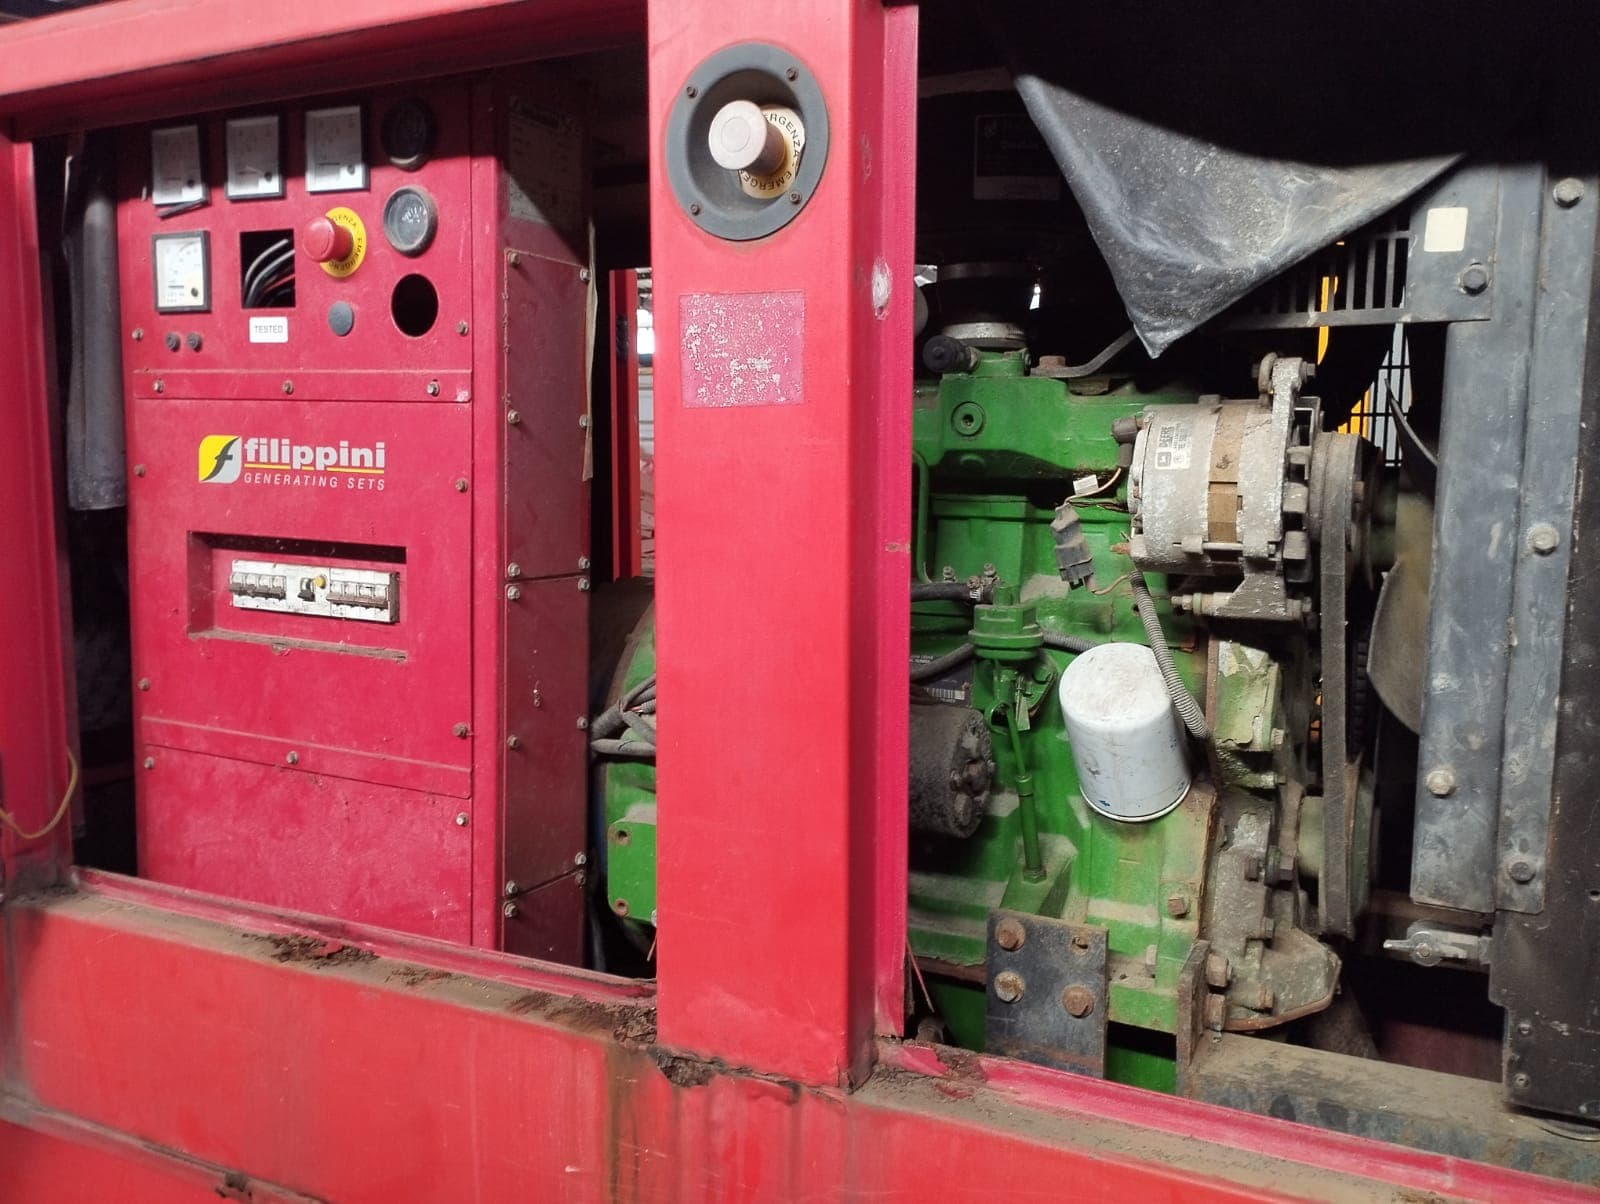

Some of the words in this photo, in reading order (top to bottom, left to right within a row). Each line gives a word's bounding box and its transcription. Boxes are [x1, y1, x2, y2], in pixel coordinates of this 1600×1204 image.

[254, 325, 284, 334] TESTED
[244, 438, 386, 471] filippini
[244, 473, 339, 488] GENERATING
[347, 478, 386, 492] SETS
